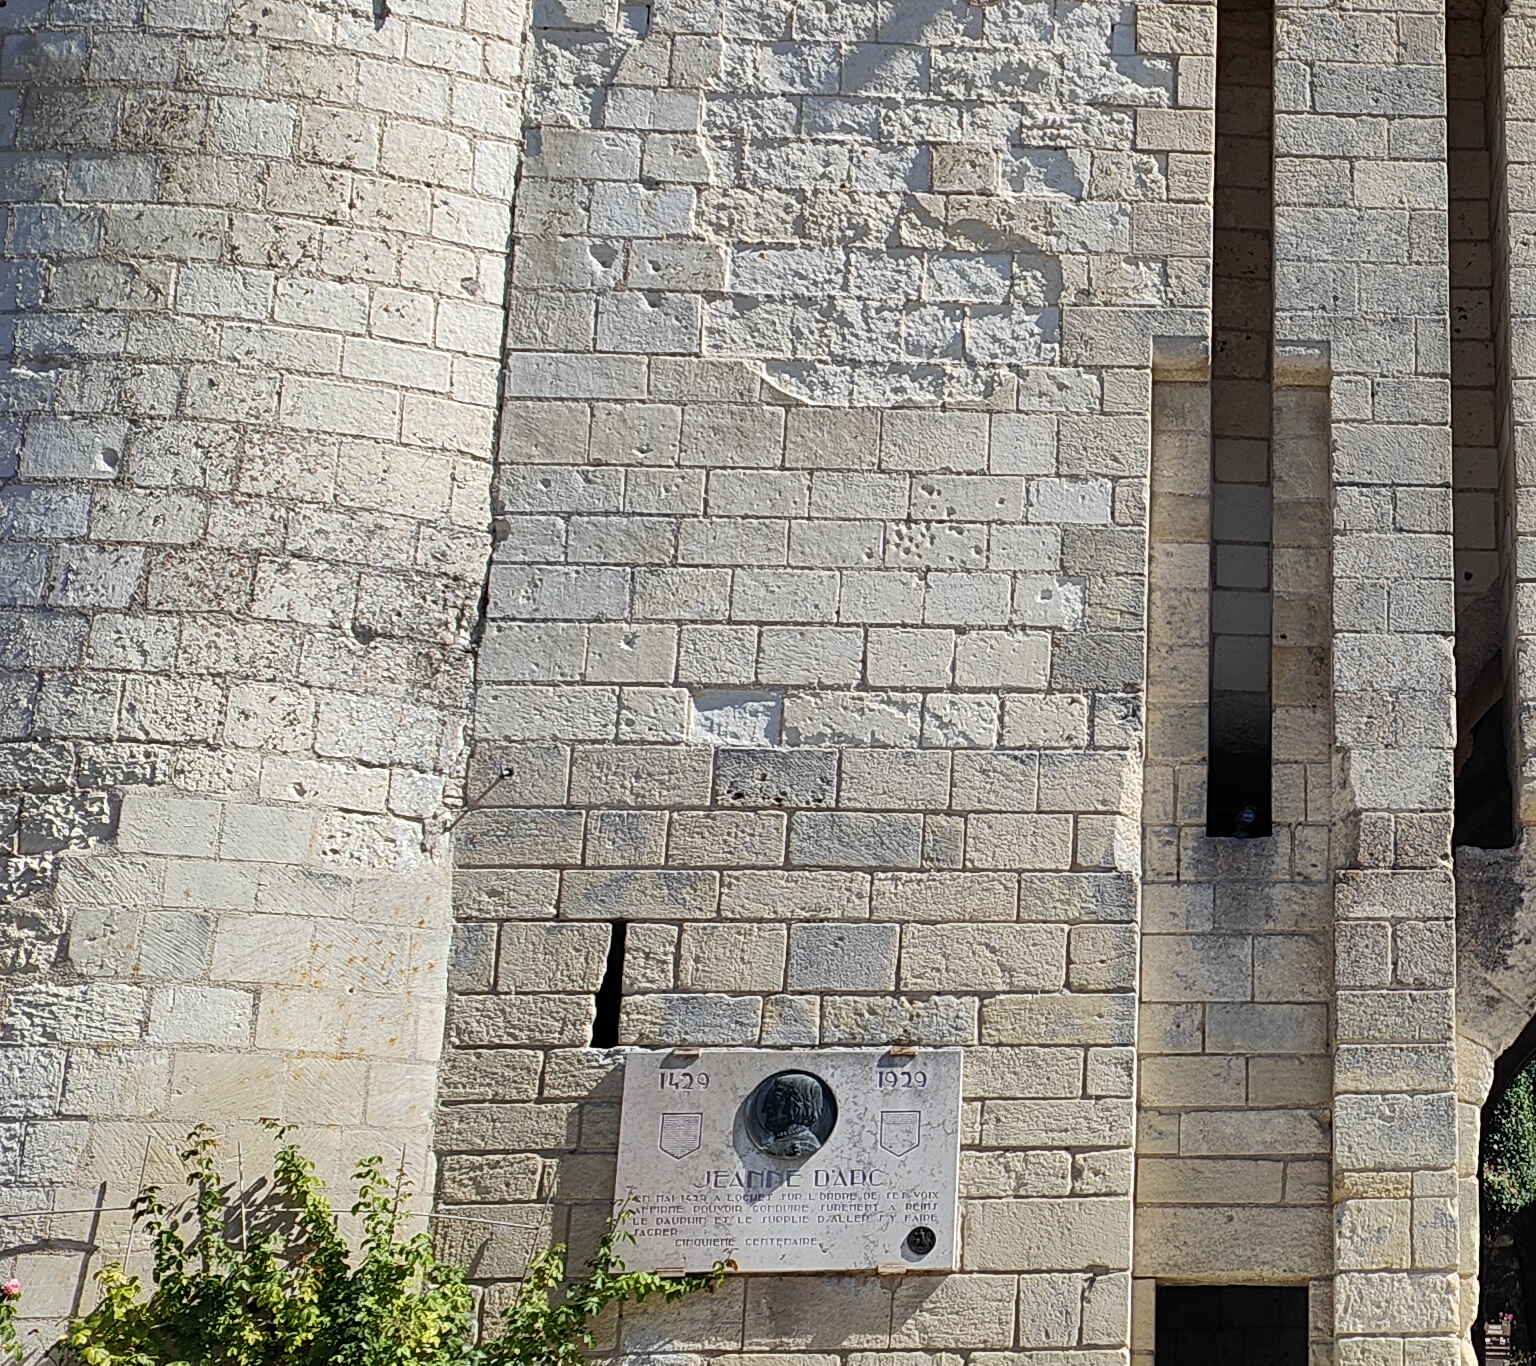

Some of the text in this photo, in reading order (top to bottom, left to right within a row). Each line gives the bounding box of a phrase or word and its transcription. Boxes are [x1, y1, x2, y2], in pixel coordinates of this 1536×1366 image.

[660, 1072, 710, 1090] 1429
[878, 1070, 927, 1089] 1929
[693, 1168, 886, 1188] JEANNE D'ARC
[656, 1194, 675, 1203] MAI
[681, 1194, 707, 1203] 1429
[779, 1193, 802, 1202] SUR
[863, 1191, 878, 1201] DE
[886, 1191, 906, 1200] SES
[913, 1190, 939, 1200] VOIX
[635, 1205, 684, 1214] AFFIRME
[693, 1204, 743, 1214] POUVOIR
[752, 1204, 809, 1213] CONDUIRE
[905, 1202, 938, 1211] REIMS
[632, 1216, 648, 1226] LE
[656, 1216, 707, 1225] DAUPHIN
[714, 1216, 730, 1225] ET
[737, 1215, 752, 1224] LE
[761, 1215, 810, 1224] SUPPLIE
[904, 1213, 938, 1223] FAIRE
[633, 1228, 678, 1237] SACRER
[745, 1237, 817, 1246] CENTENAIRE
